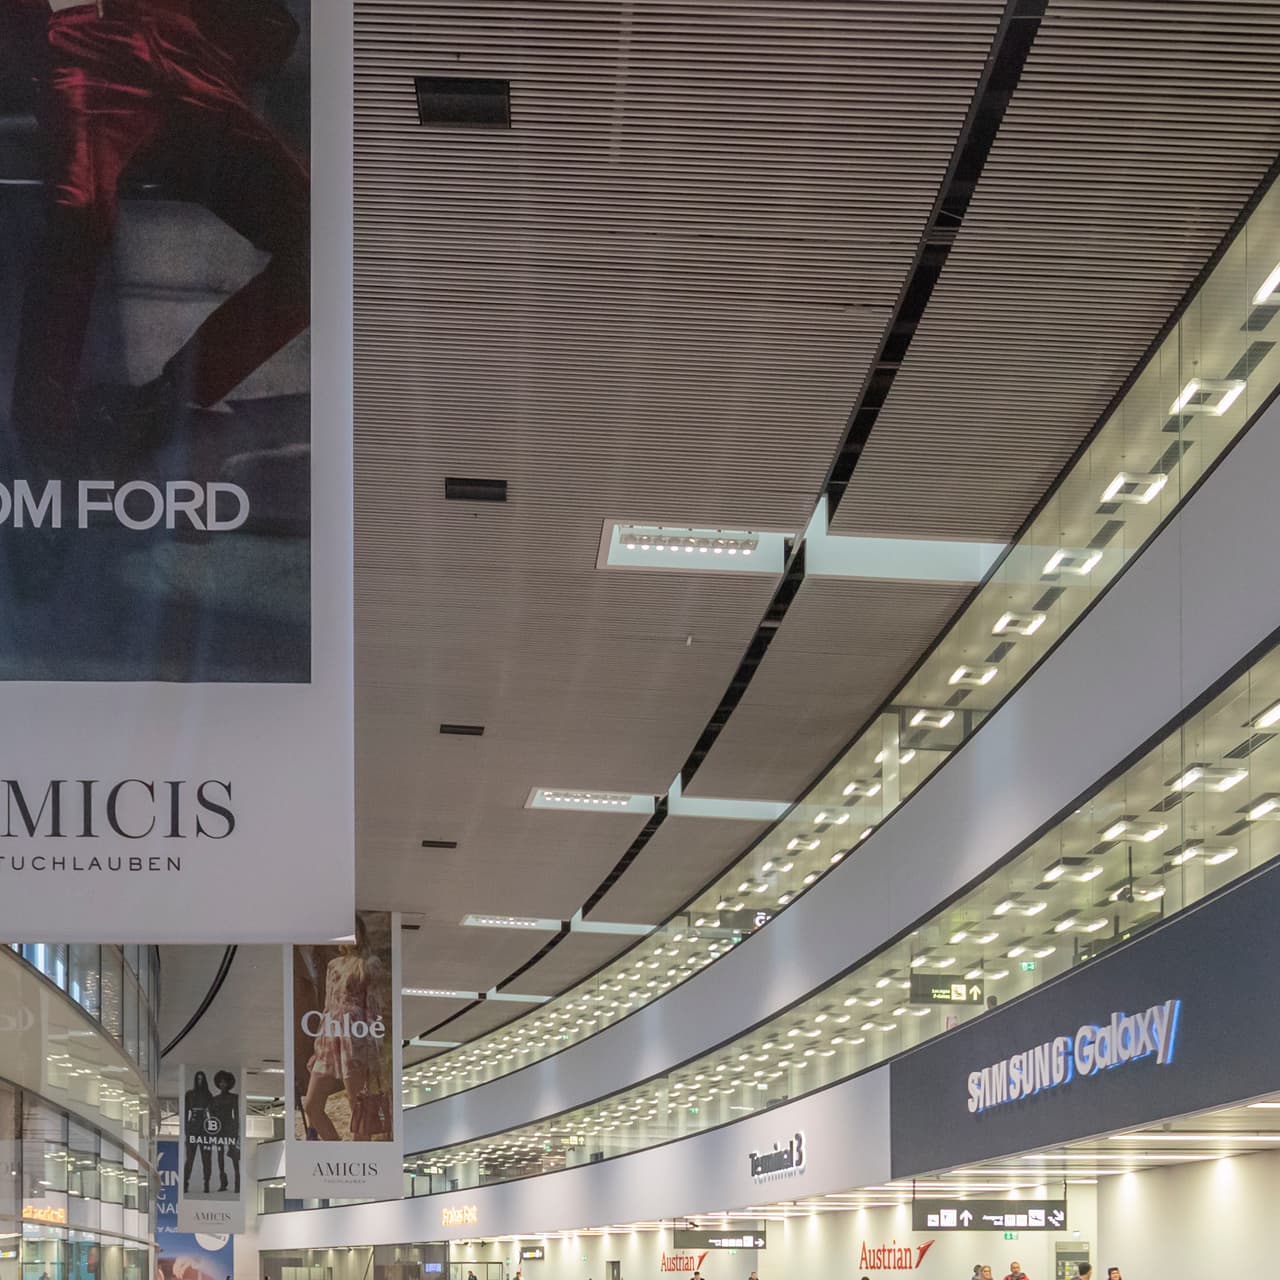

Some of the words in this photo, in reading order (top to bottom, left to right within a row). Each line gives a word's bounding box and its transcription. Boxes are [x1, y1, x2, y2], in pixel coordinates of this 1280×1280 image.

[79, 480, 250, 532] FORD
[301, 1010, 385, 1038] Chloé
[968, 1036, 1072, 1112] SAMSUNG
[1074, 1000, 1181, 1077] Galaxy
[189, 1135, 236, 1145] BALMAIN
[794, 1132, 804, 1167] 3
[312, 1161, 378, 1178] AMICIS
[660, 1250, 695, 1272] Austrian
[859, 1239, 912, 1270] Austrian
